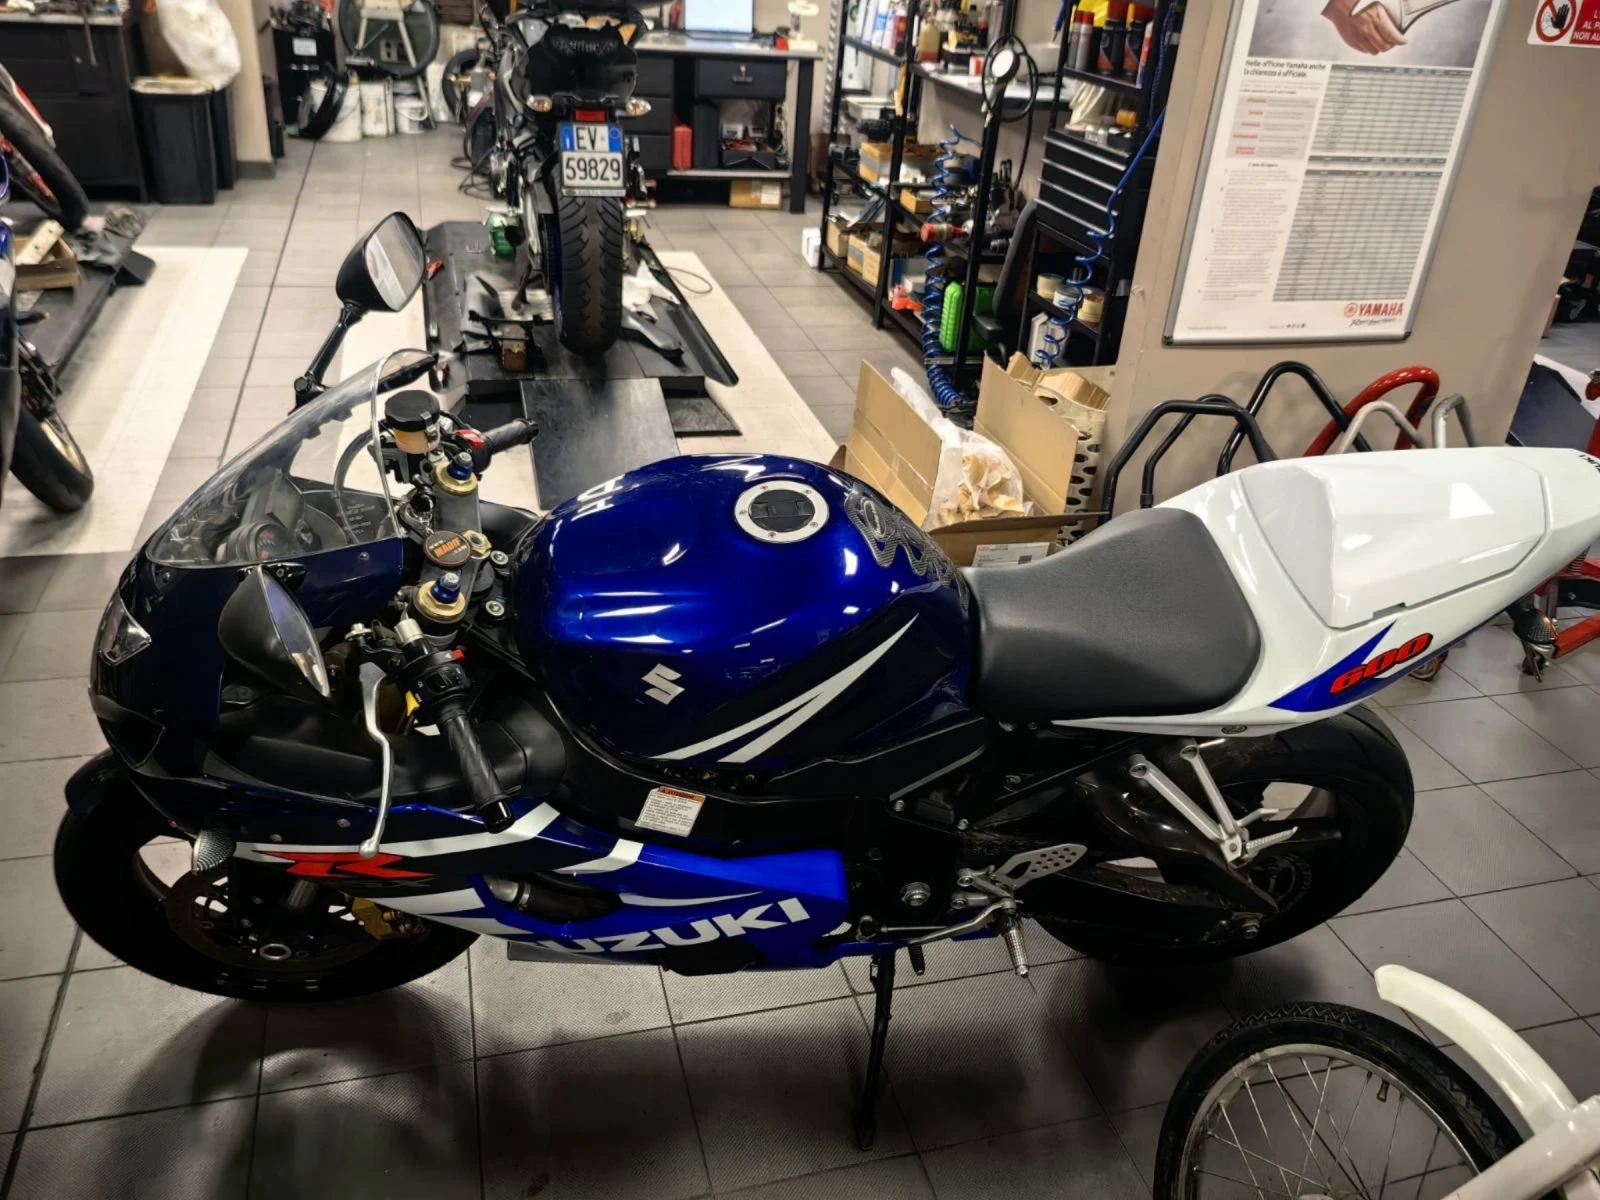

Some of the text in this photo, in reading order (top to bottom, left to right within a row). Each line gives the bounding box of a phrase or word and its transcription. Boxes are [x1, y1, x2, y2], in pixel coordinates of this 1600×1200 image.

[1573, 32, 1591, 40] NON
[576, 127, 597, 150] EV
[565, 157, 621, 181] 59829
[1360, 303, 1404, 316] YAMAHA
[1329, 632, 1433, 696] 600
